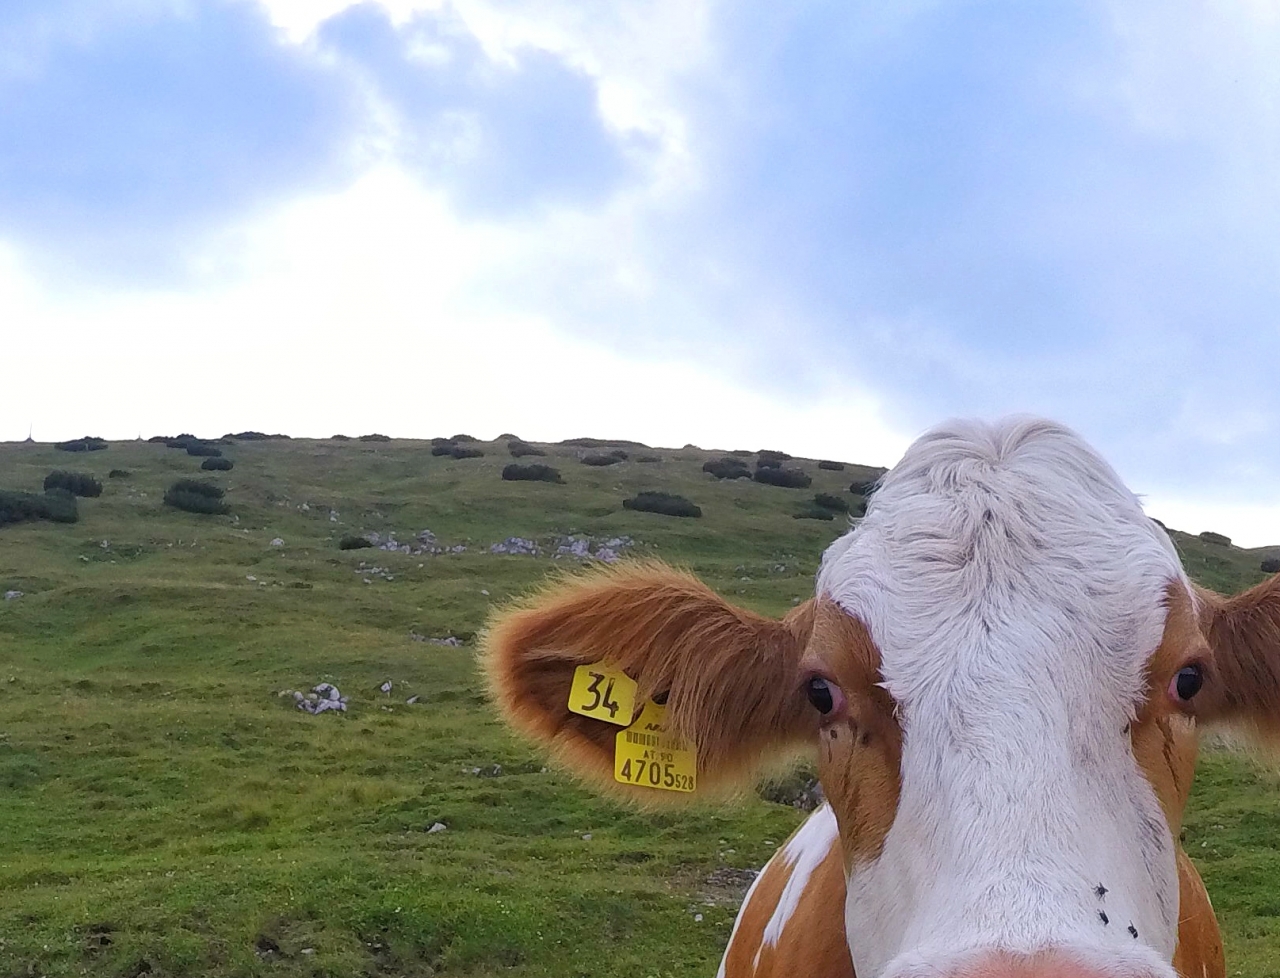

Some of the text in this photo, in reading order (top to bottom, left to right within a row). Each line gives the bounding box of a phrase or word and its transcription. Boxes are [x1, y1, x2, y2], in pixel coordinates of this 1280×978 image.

[581, 671, 620, 718] 34
[621, 758, 694, 790] 4705 528
